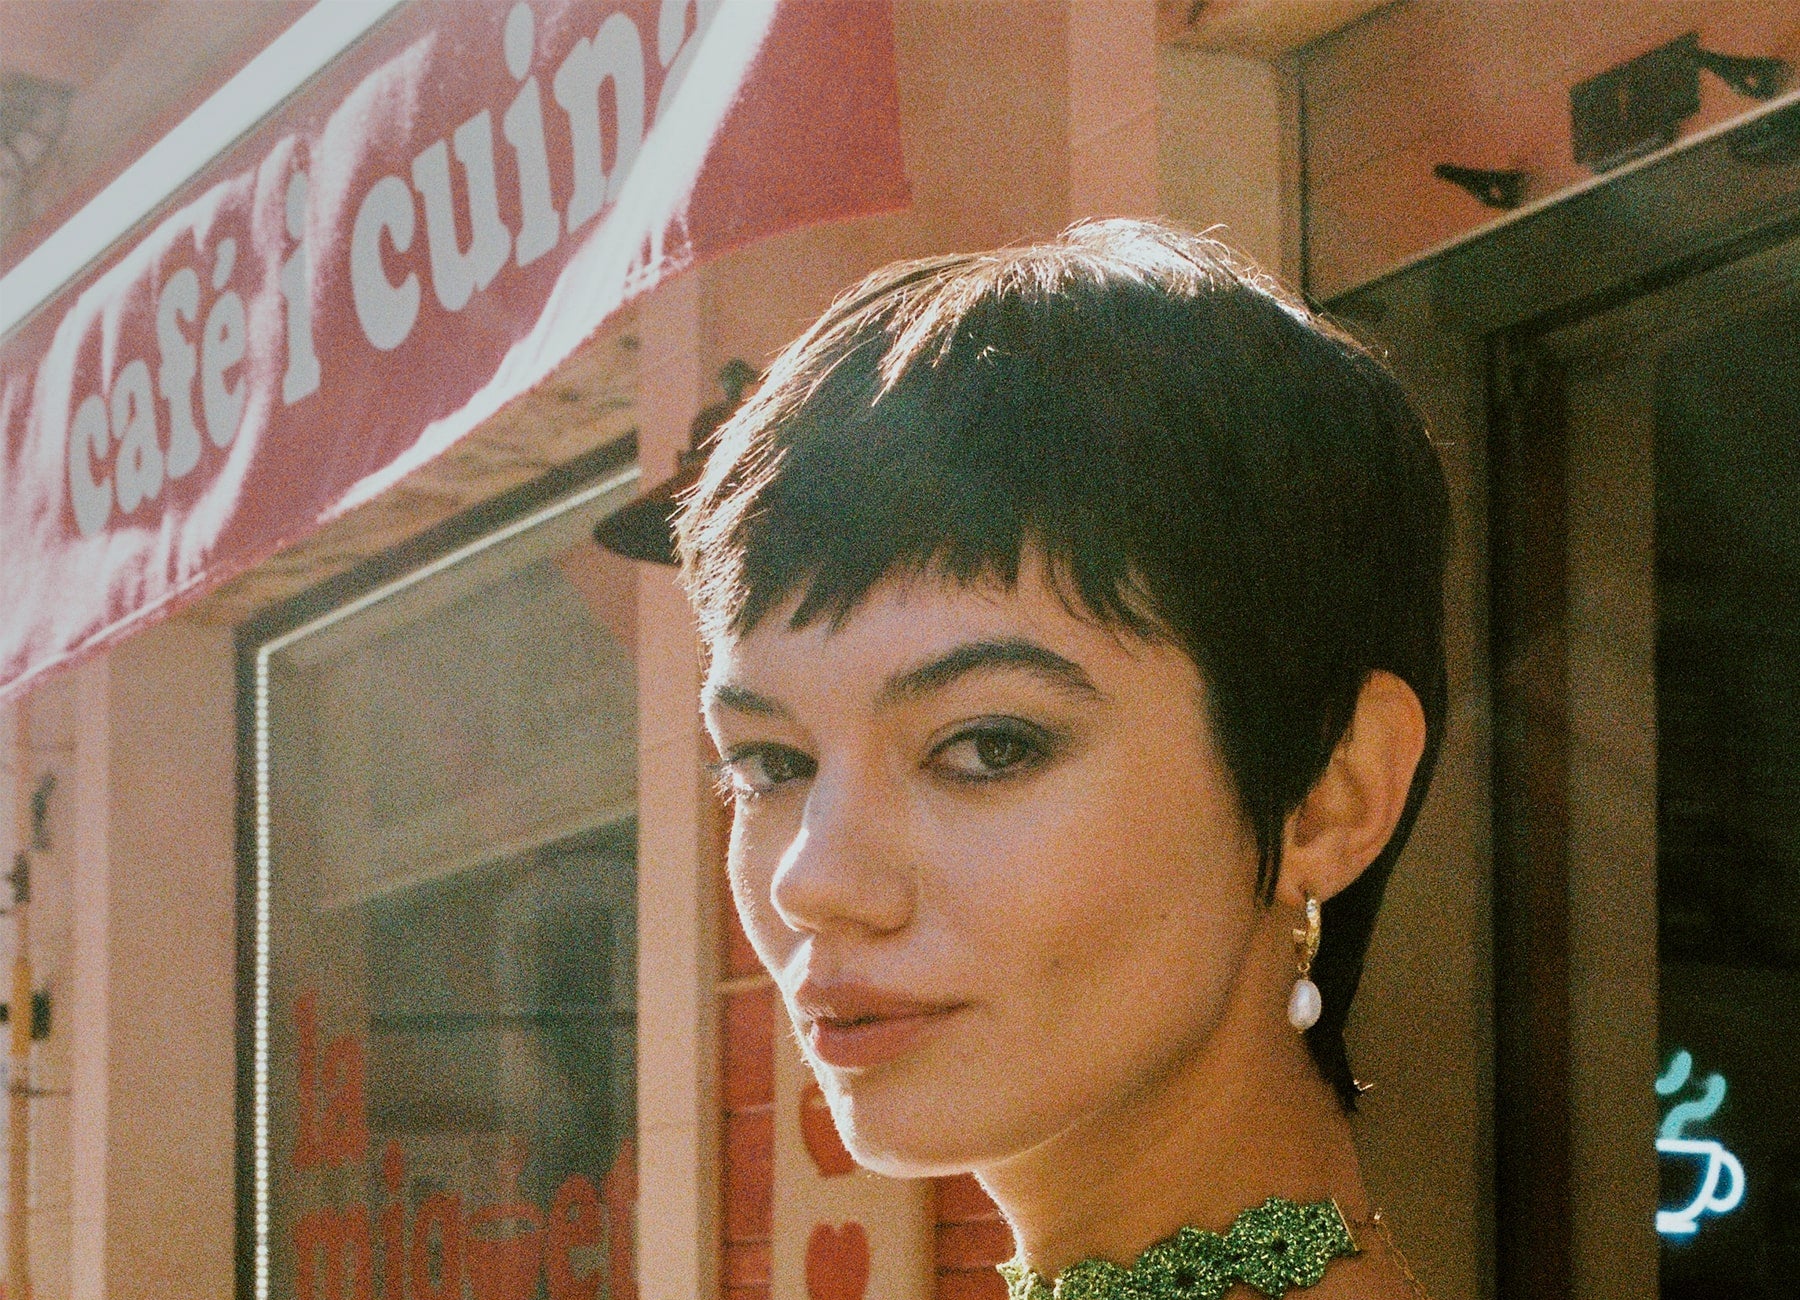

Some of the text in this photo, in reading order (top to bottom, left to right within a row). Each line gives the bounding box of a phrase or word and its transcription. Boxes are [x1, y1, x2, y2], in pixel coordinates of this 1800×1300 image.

[70, 238, 247, 538] café
[280, 165, 321, 406] i
[292, 989, 370, 1171] la
